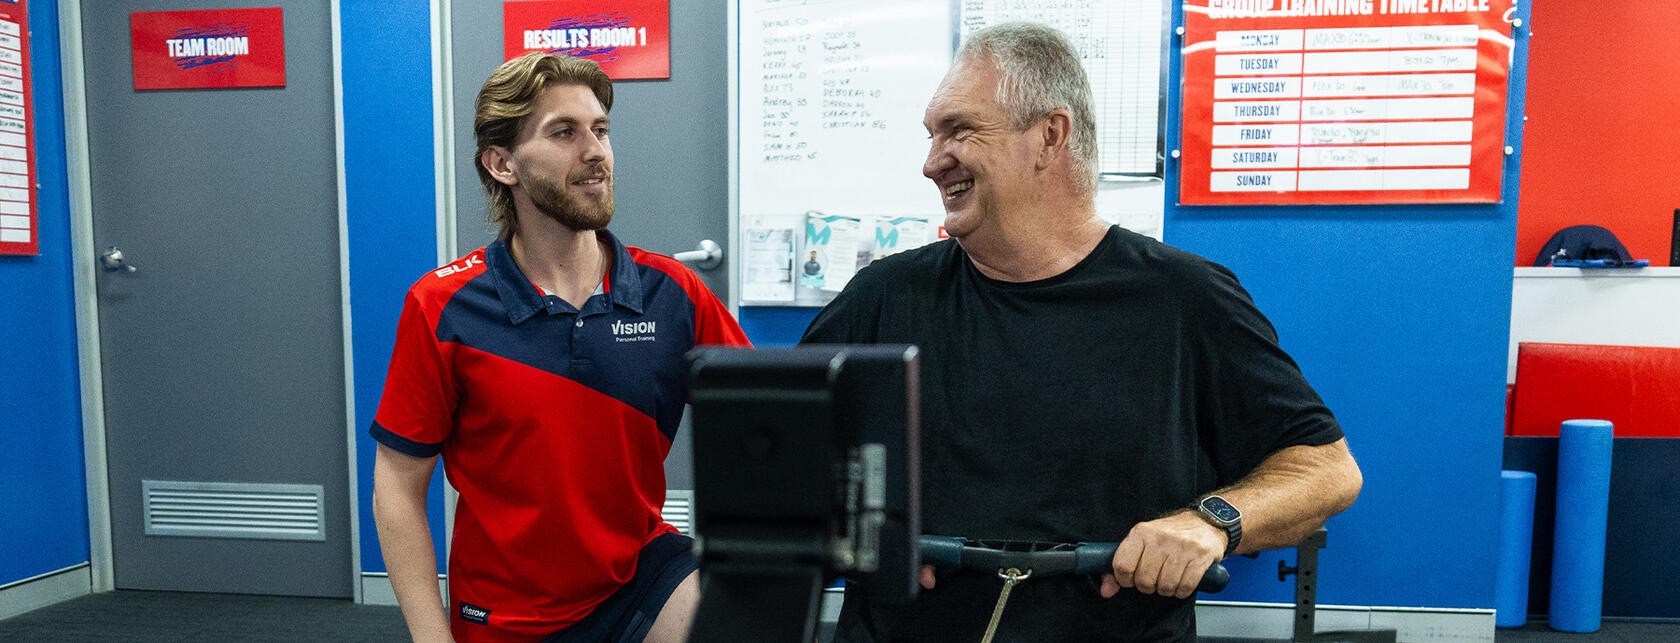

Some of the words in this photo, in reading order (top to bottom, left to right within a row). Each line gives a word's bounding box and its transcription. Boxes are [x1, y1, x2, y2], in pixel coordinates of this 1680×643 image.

[524, 28, 589, 49] RESULTS
[590, 27, 636, 47] ROOM
[638, 27, 647, 46] 1
[1240, 34, 1280, 47] MONDAY
[166, 38, 205, 57] TEAM
[207, 36, 249, 56] ROOM
[1239, 58, 1280, 70] TUESDAY
[823, 88, 866, 98] DEBORAH
[1231, 81, 1287, 93] WEDNESDAY
[1234, 104, 1281, 117] THURSDAY
[1240, 128, 1272, 140] FRIDAY
[1232, 151, 1278, 163] SATURDAY
[1236, 174, 1272, 187] SUNDAY
[435, 254, 484, 278] BLK
[611, 320, 656, 336] VISION
[637, 335, 656, 343] Training
[462, 605, 486, 618] VISION
